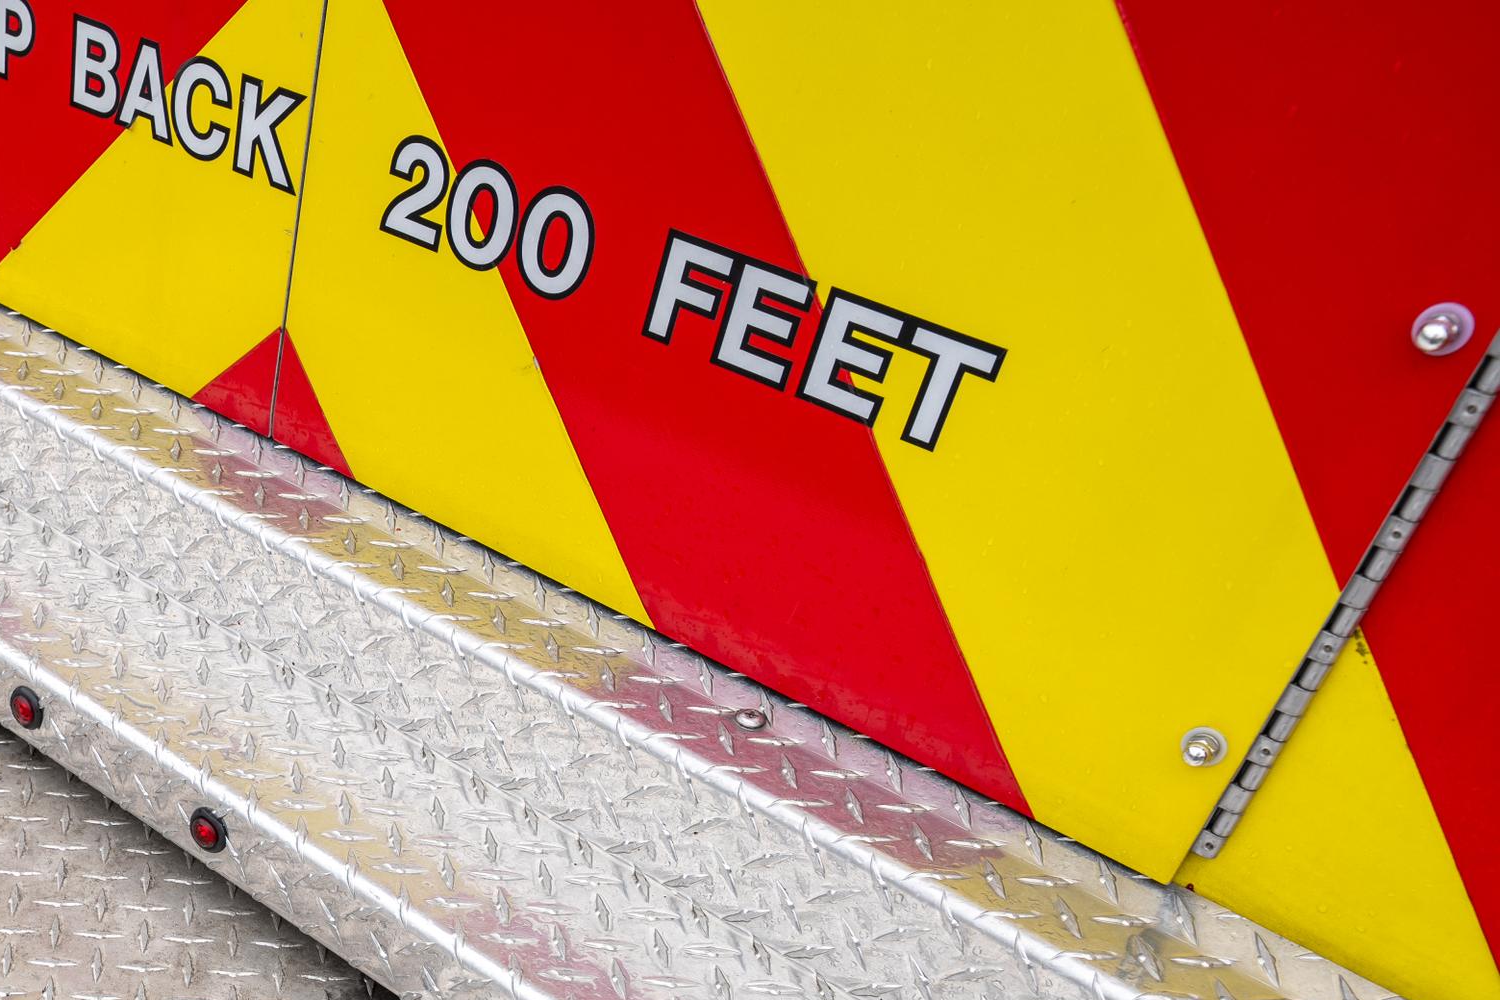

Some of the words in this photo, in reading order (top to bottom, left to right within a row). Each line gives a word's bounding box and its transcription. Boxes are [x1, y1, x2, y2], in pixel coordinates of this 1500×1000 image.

[70, 14, 307, 196] BACK
[379, 134, 595, 300] 200
[641, 228, 1008, 452] FEET
